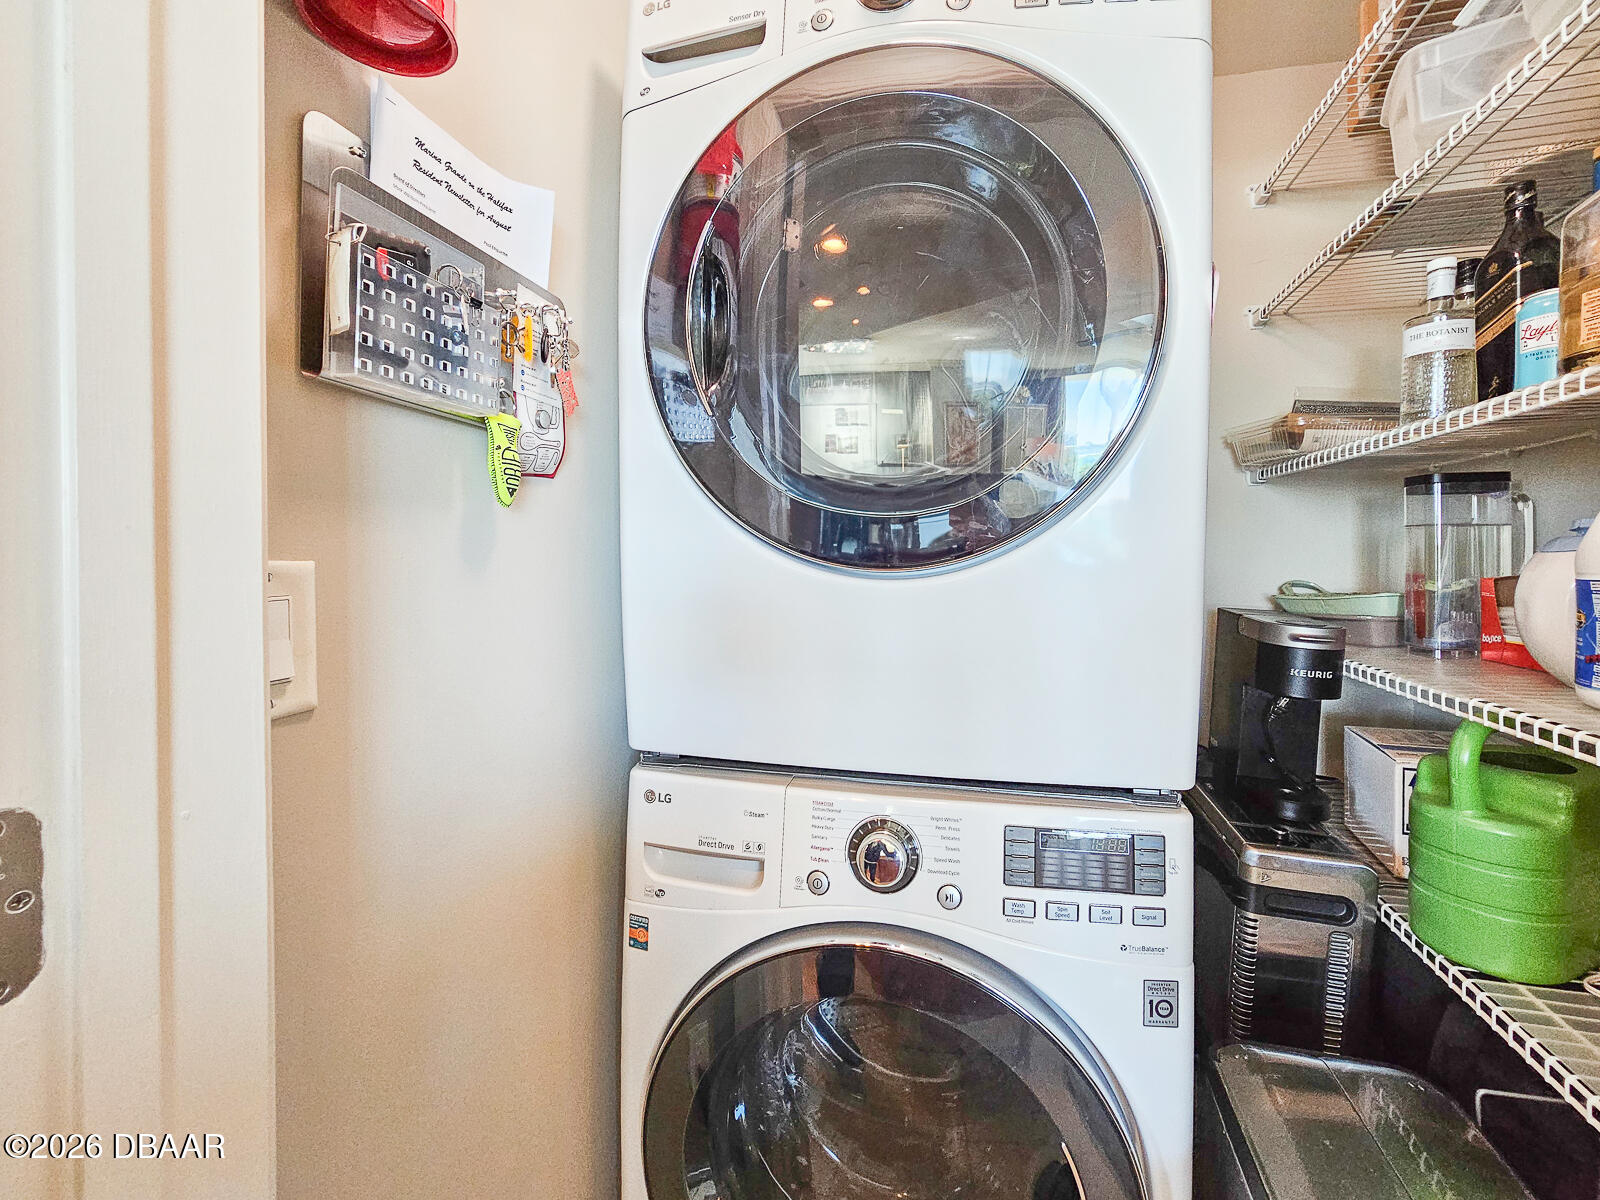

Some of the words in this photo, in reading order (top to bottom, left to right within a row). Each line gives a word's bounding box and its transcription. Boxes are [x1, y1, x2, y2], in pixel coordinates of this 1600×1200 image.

[728, 12, 752, 23] Sensor
[753, 9, 767, 19] Dry
[414, 136, 442, 164] Marina
[444, 161, 467, 183] Grande
[476, 187, 485, 198] the
[486, 192, 513, 214] Halifax
[412, 159, 443, 187] Resident
[443, 180, 475, 210] Newsletter
[476, 206, 485, 216] for
[486, 214, 512, 232] August
[1409, 333, 1424, 341] THE
[1425, 327, 1470, 338] BOTANIST
[1290, 668, 1333, 679] KEURIG
[658, 793, 672, 803] LG
[698, 839, 717, 849] Direct
[718, 841, 735, 851] Drive
[1011, 907, 1025, 915] Temp
[1148, 999, 1174, 1019] 10
